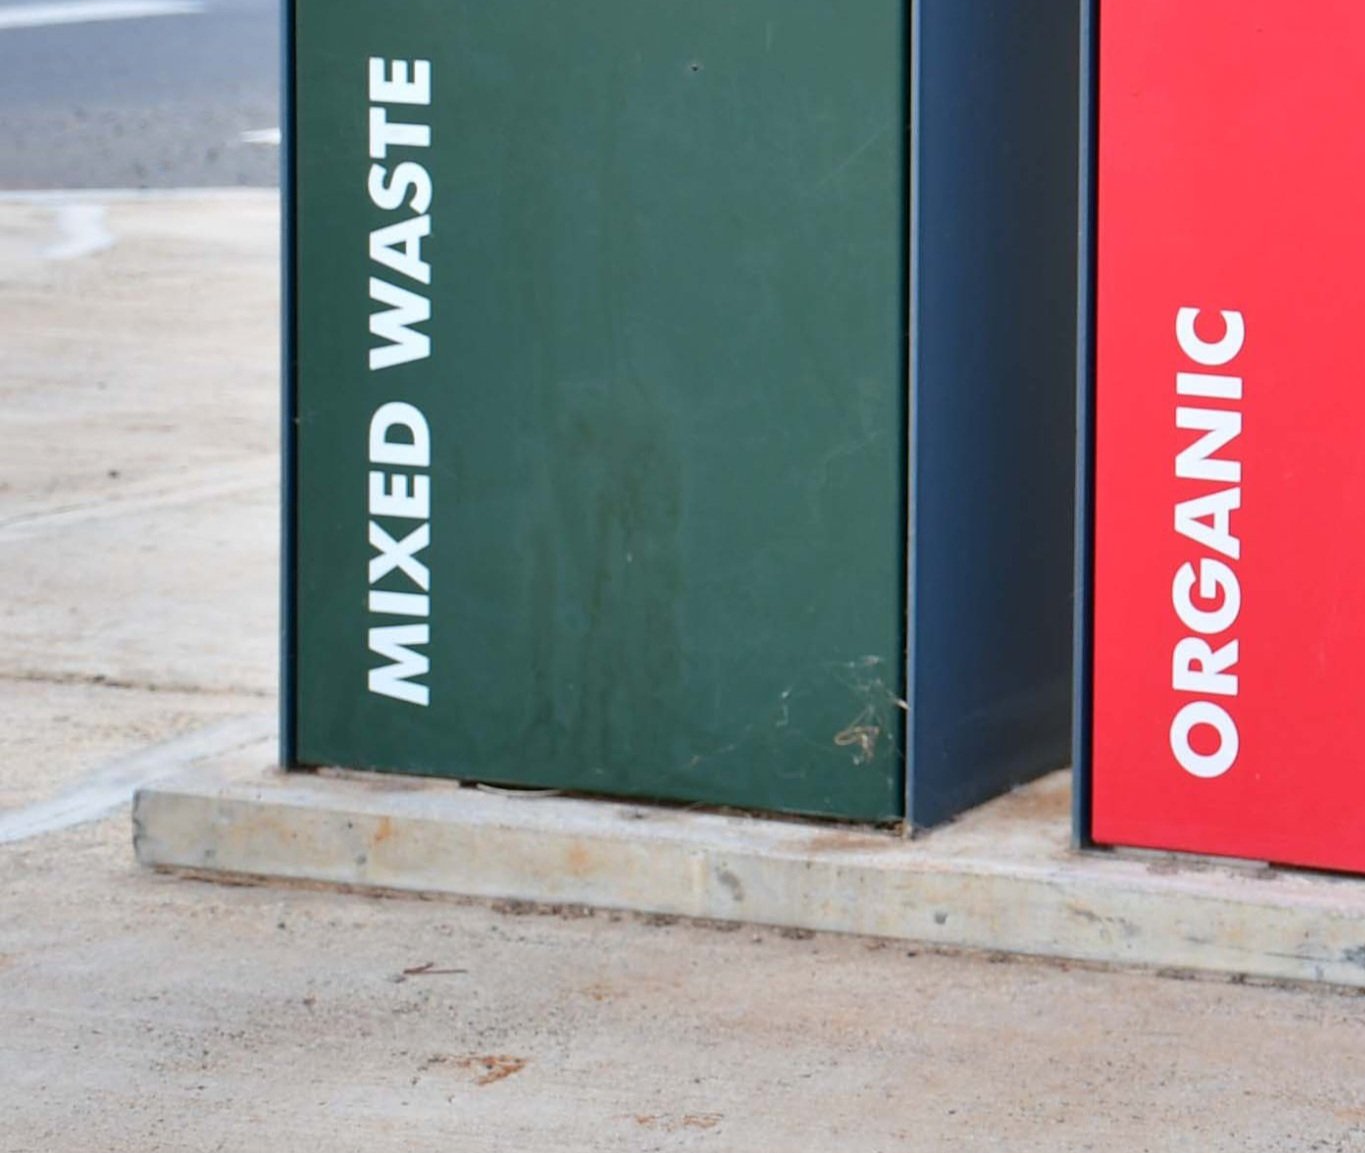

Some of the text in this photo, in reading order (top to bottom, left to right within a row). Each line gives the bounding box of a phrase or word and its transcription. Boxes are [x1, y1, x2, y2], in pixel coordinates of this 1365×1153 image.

[369, 58, 430, 705] MIXED WASTE
[1170, 308, 1245, 776] ORGANIC
